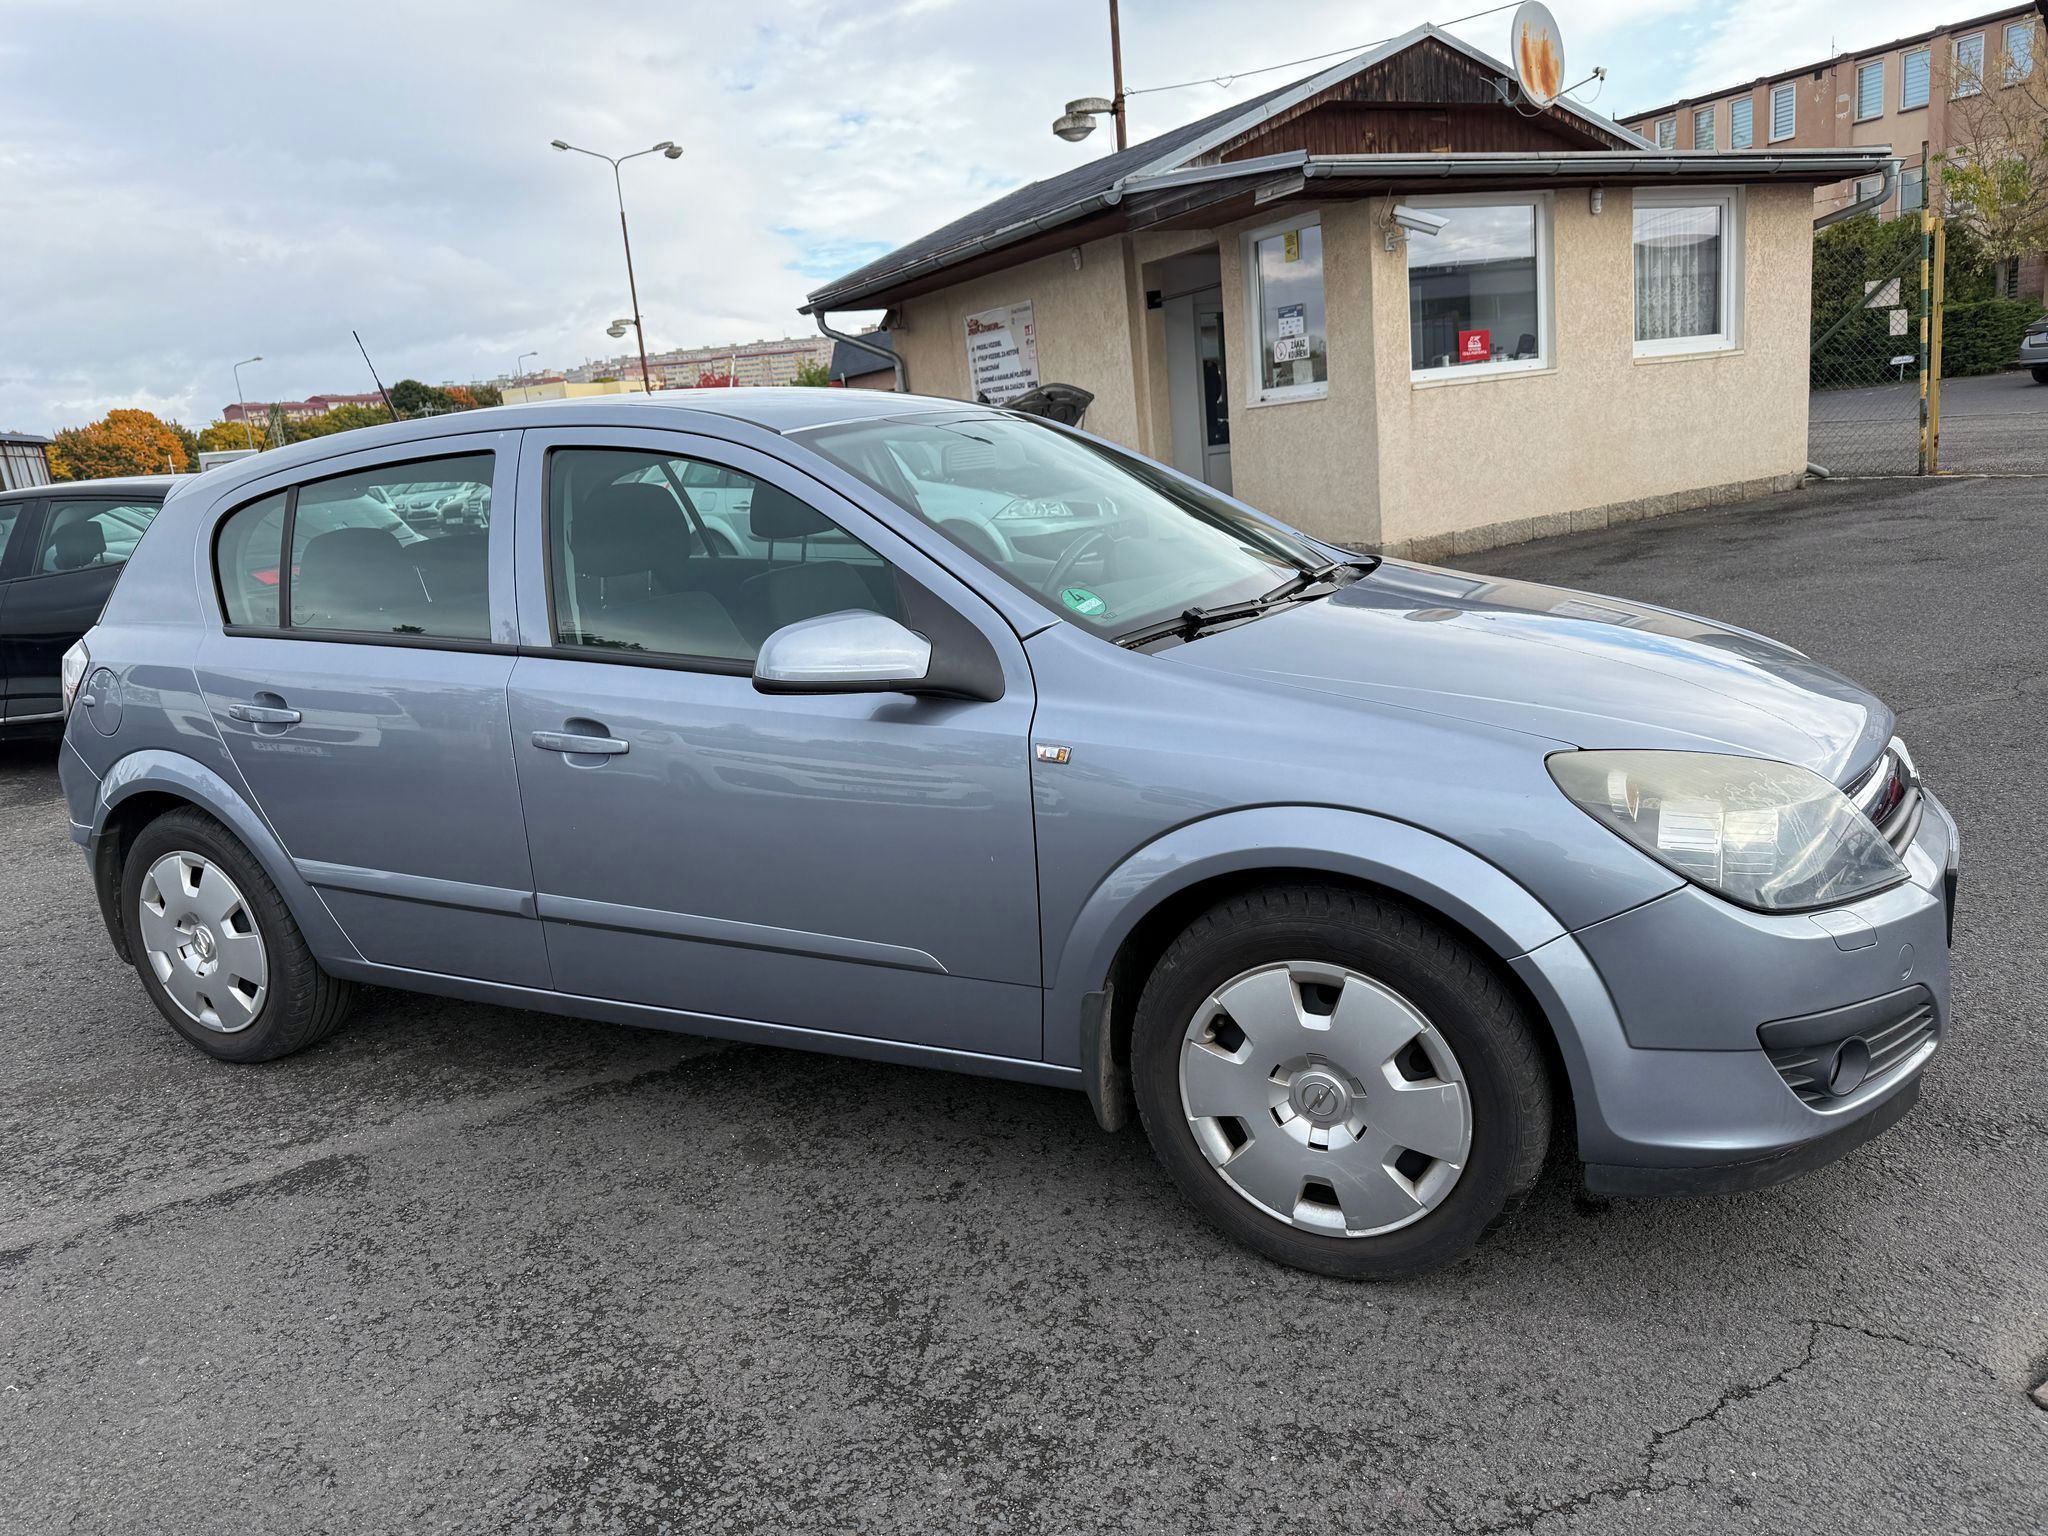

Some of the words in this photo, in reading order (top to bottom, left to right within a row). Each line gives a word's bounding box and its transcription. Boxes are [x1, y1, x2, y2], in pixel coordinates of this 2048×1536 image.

[1291, 340, 1305, 349] ZÁKAZ
[1288, 349, 1308, 359] KOUŘENÍ
[1068, 590, 1086, 601] 4
